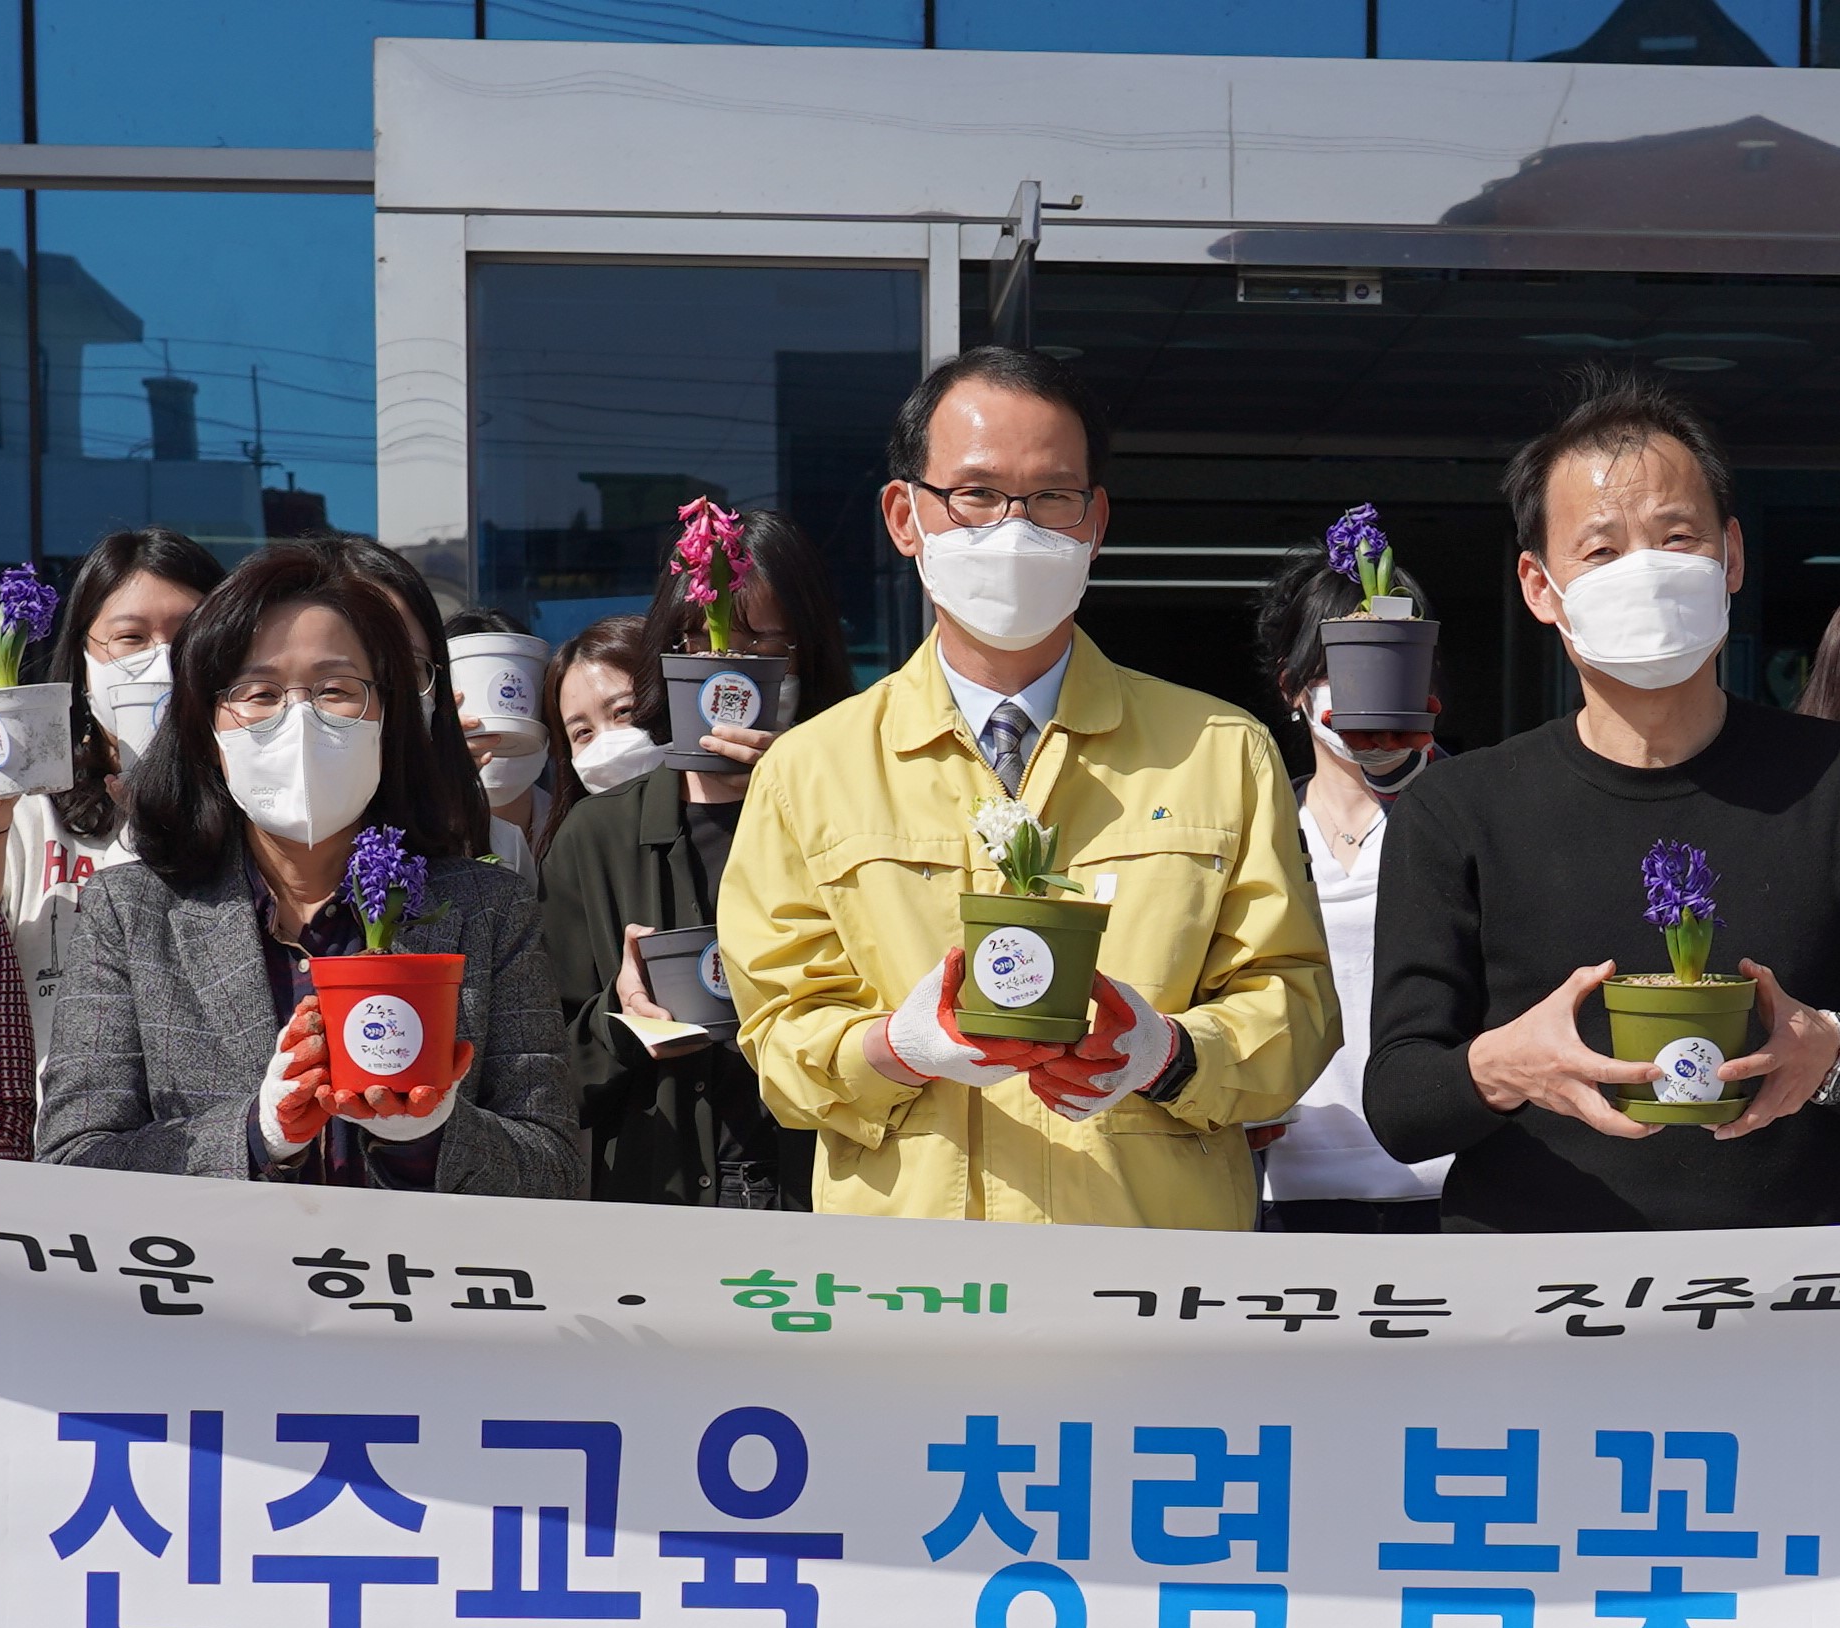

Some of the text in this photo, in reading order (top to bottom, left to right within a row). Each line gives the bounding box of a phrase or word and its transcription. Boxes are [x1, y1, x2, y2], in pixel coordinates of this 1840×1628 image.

[38, 984, 57, 998] OF
[293, 1248, 546, 1322] 학교
[721, 1269, 1007, 1332] 함께
[1093, 1284, 1452, 1338] 가꾸는
